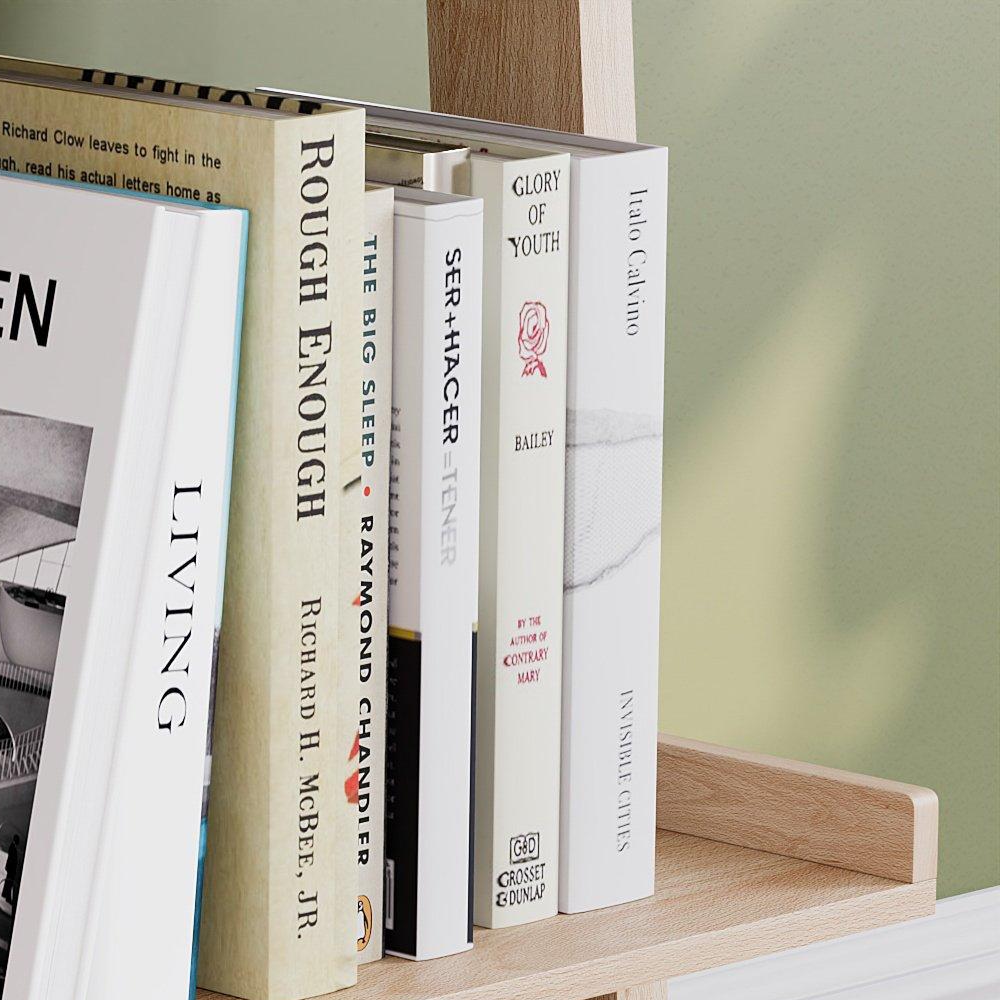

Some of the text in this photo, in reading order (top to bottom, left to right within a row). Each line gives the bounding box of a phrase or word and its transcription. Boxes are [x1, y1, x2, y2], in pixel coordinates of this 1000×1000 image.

[2, 121, 48, 142] Richard
[54, 129, 85, 148] Clow
[89, 135, 129, 154] leaves
[135, 143, 147, 157] to
[153, 145, 179, 165] fight
[184, 149, 195, 165] in
[202, 153, 221, 169] the
[24, 161, 52, 177] read
[58, 164, 76, 181] his
[81, 170, 117, 187] actual
[122, 174, 161, 194] letters
[166, 181, 200, 200] home
[206, 191, 221, 204] as
[512, 169, 561, 197] GLORY
[528, 203, 547, 226] OF
[508, 230, 561, 258] YOUTH
[626, 189, 648, 336] Italo Calvino
[297, 134, 335, 522] ROUGH ENOUGH
[361, 234, 378, 467] THE BIG SLEEP
[515, 430, 554, 452] BAILEY
[157, 479, 203, 734] LIVING
[360, 515, 374, 683] RAYMOND
[510, 630, 548, 646] AUTHOR OF
[517, 615, 542, 629] BY THE
[300, 596, 322, 720] RICHARD
[503, 648, 549, 667] CONTRARY
[517, 668, 541, 684] MARY
[299, 730, 321, 762] H.
[615, 689, 634, 852] INVISIBLE CITIES
[497, 863, 546, 888] GROSSET
